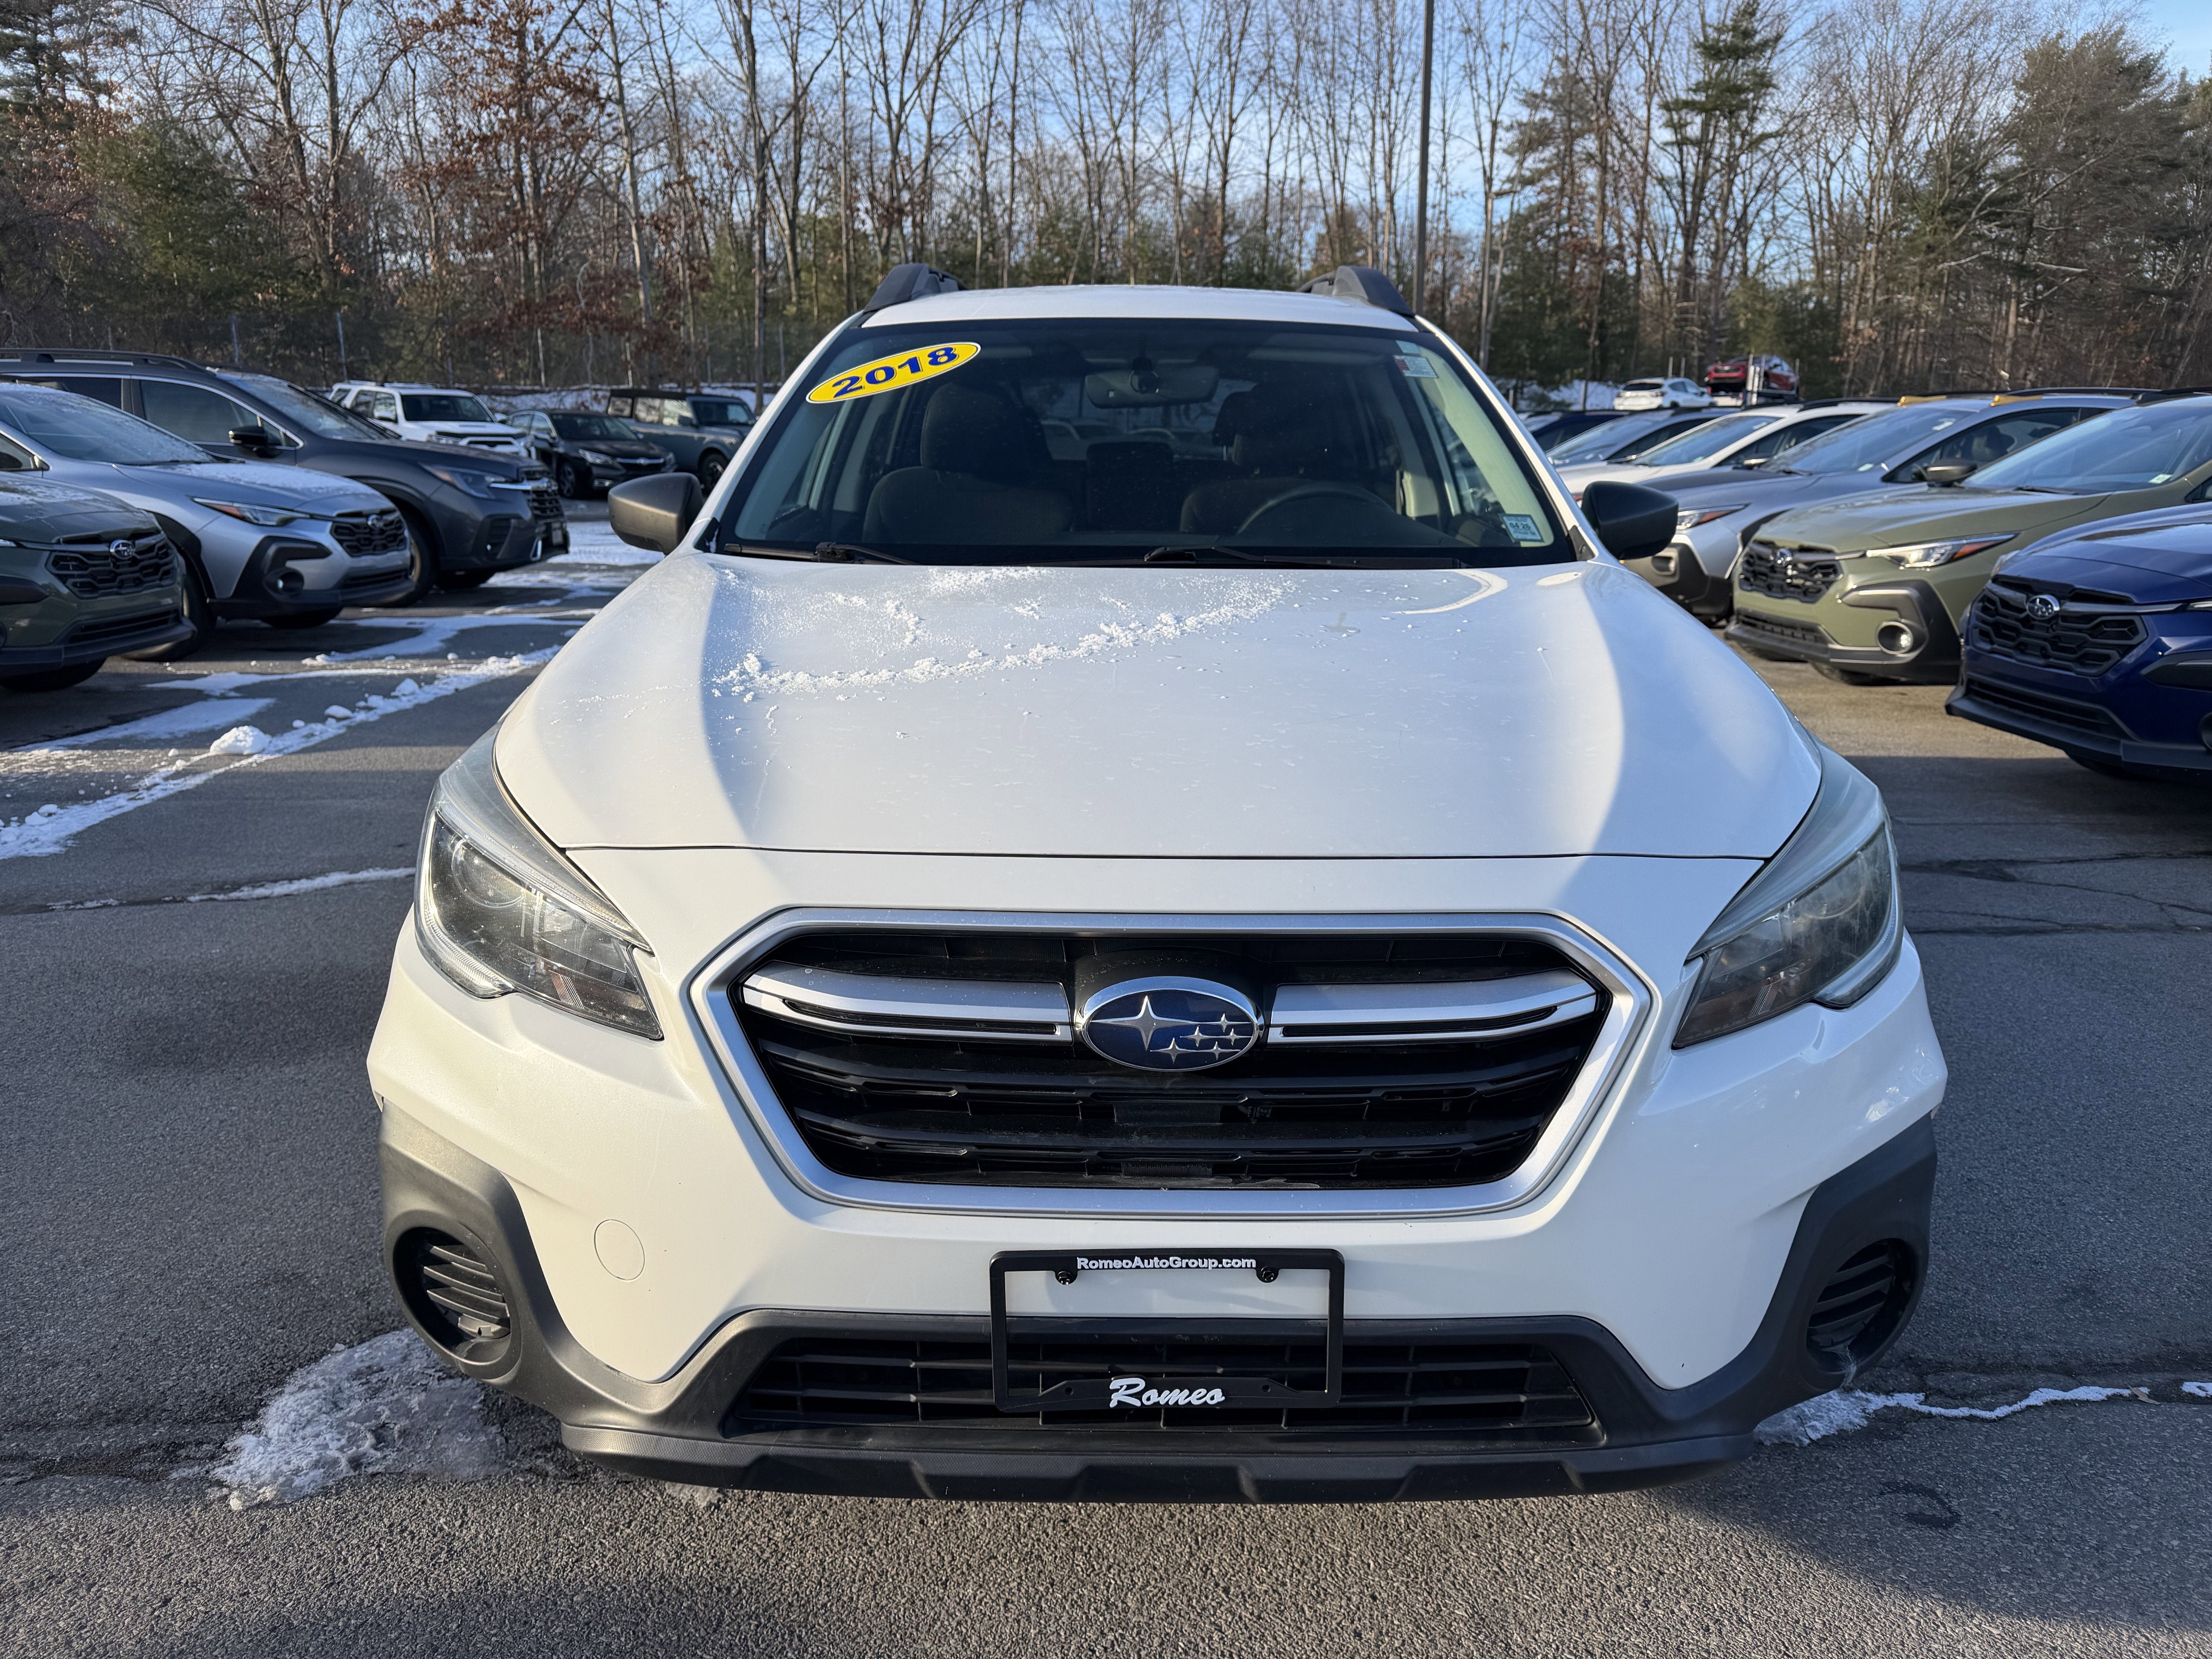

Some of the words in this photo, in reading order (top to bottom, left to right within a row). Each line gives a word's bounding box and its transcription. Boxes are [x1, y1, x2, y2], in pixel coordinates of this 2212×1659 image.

[832, 347, 958, 398] 2018
[1077, 1256, 1256, 1270] RomeoAutoGroup.com
[1109, 1377, 1225, 1408] Romeo
